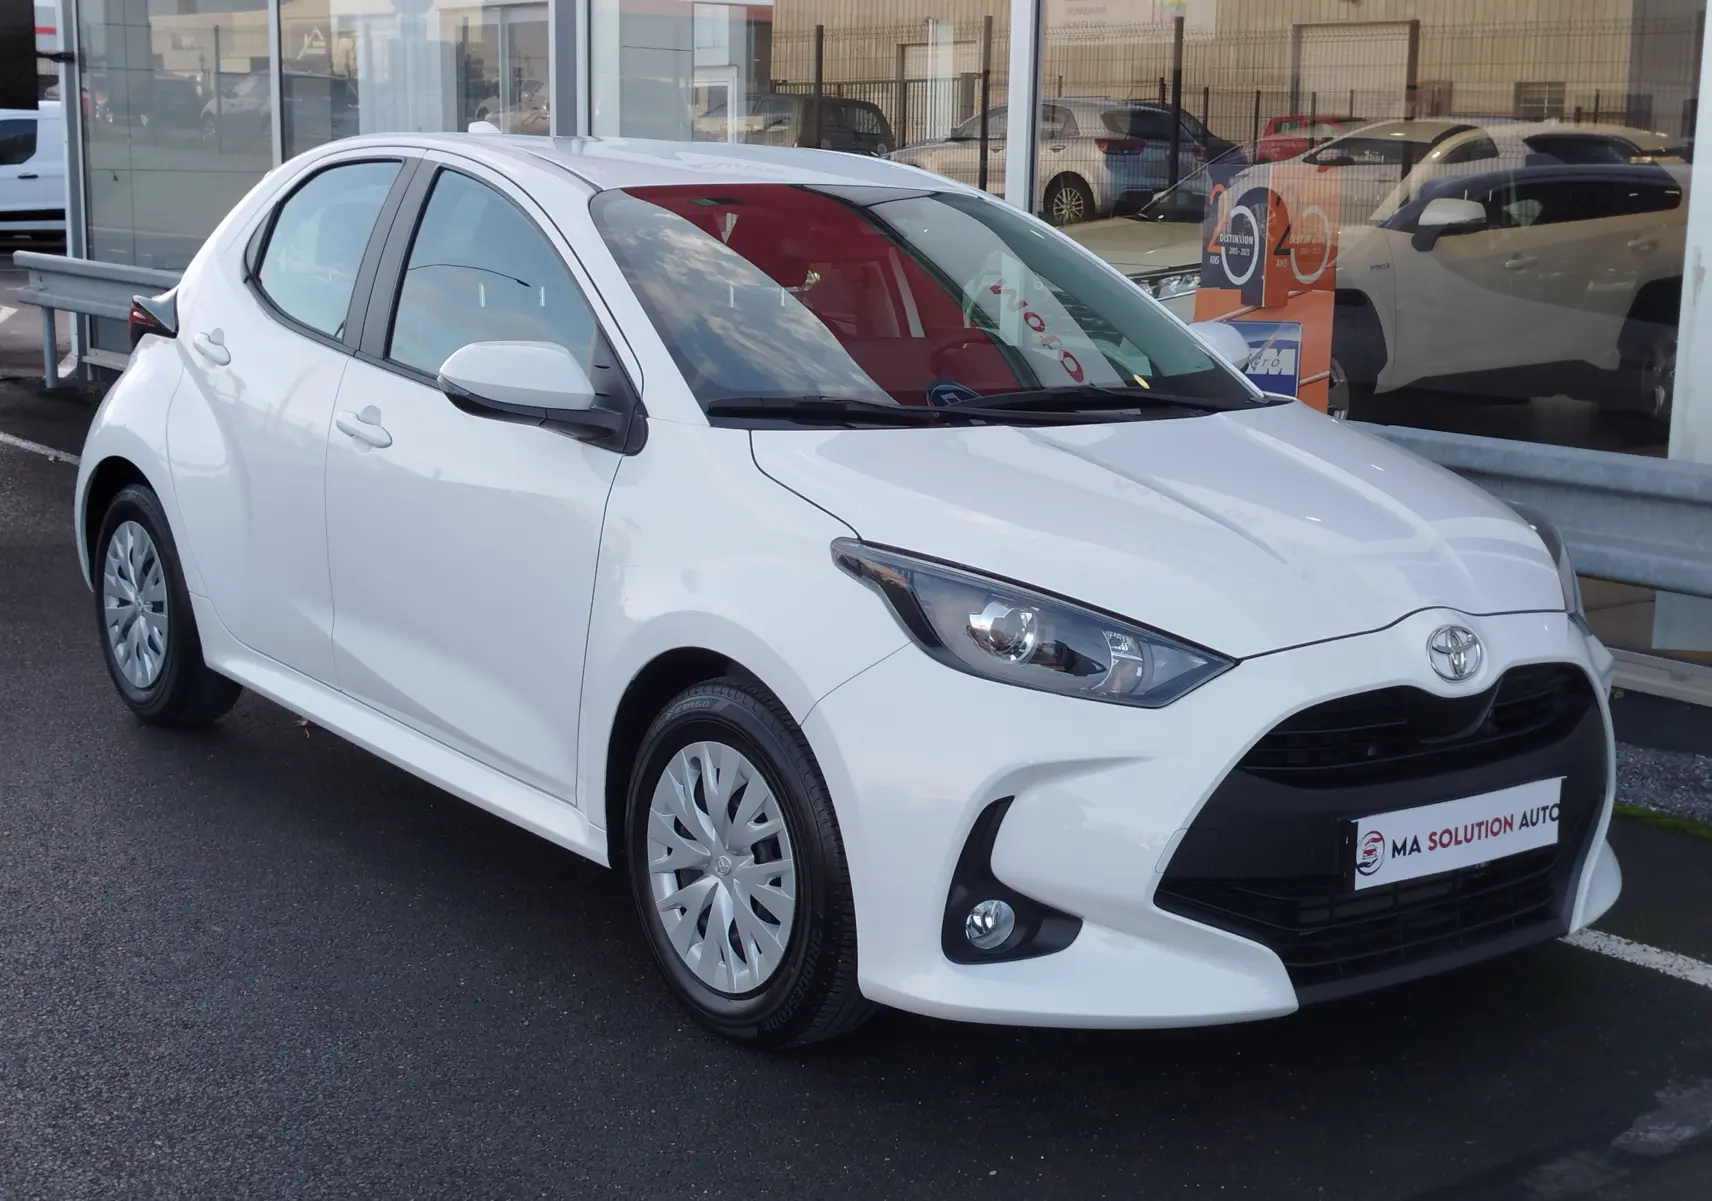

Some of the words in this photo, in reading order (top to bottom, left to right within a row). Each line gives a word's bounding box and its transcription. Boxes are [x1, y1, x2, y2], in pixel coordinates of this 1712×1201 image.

[1209, 255, 1220, 265] ANS
[1391, 834, 1422, 858] MA
[1427, 813, 1514, 851] SOLUTION
[1518, 802, 1560, 830] AUTO
